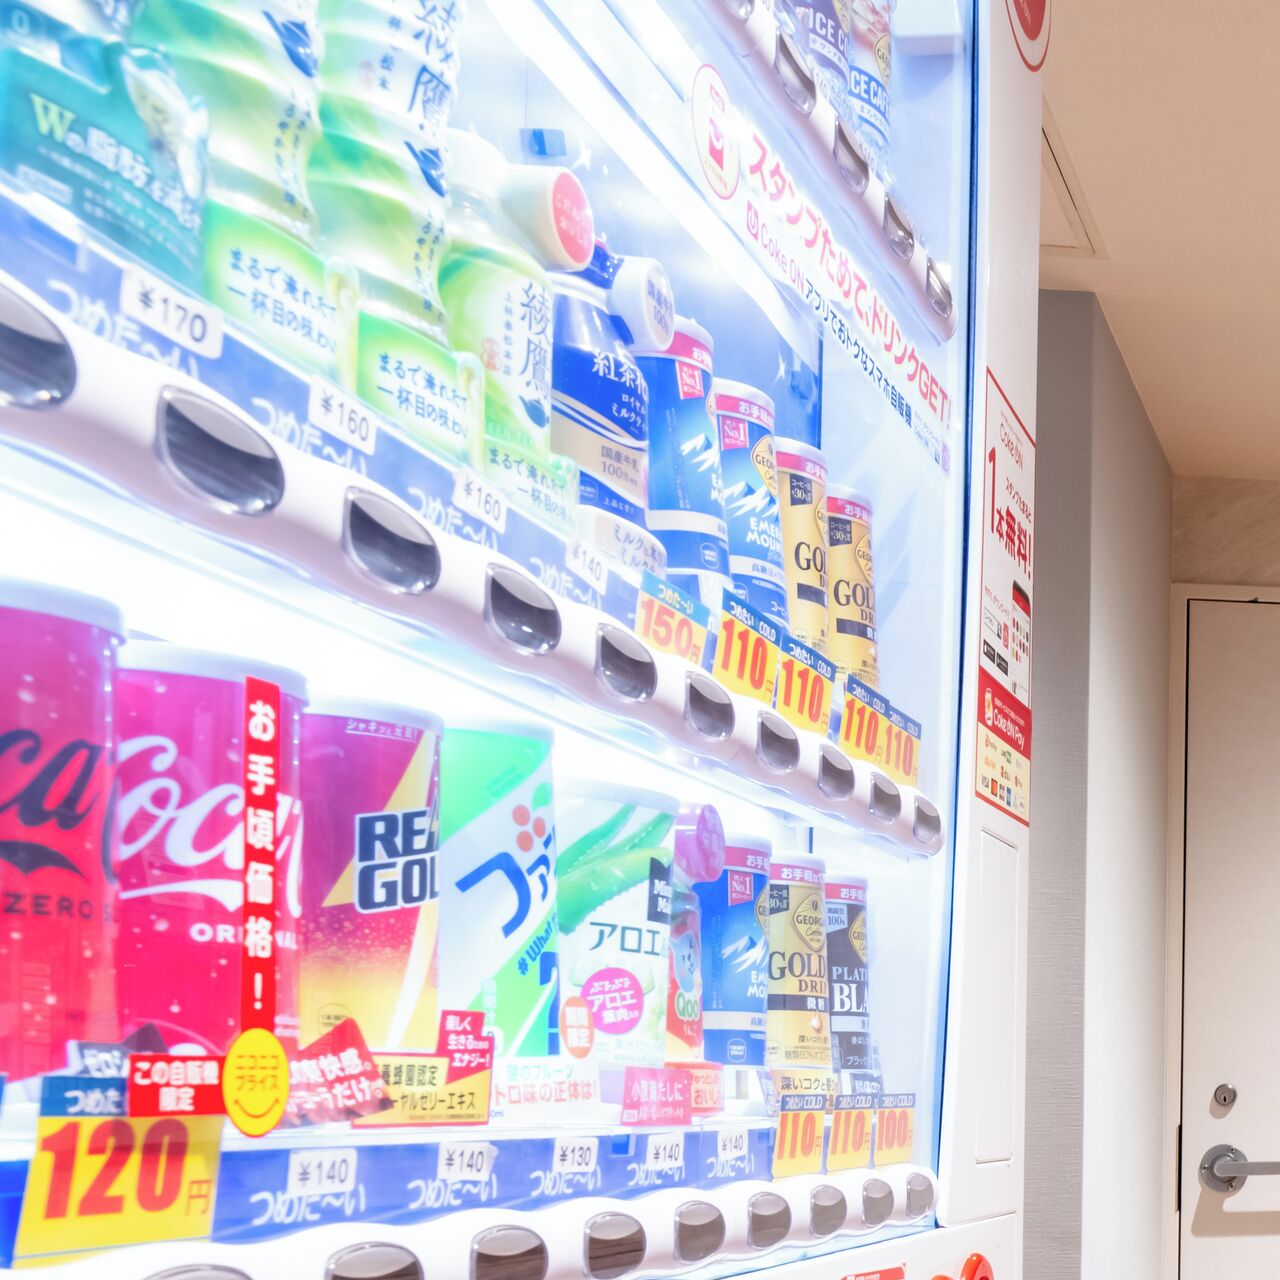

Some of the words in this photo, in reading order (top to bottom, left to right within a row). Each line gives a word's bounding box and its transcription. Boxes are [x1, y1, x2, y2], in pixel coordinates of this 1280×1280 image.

[137, 285, 208, 344] ¥170
[320, 388, 369, 443] ¥160
[463, 478, 502, 523] ¥160
[245, 699, 277, 1011] お手頃価格!
[589, 920, 661, 957] アロエ
[586, 989, 638, 1013] アロエ
[452, 1051, 492, 1068] エナジー!
[133, 1060, 220, 1086] この自販機
[159, 1086, 196, 1113] 限定
[391, 1091, 477, 1111] ーヤルゼリーエキス
[558, 1145, 592, 1168] ¥130
[652, 1142, 680, 1162] ¥140
[720, 1134, 744, 1153] ¥140
[298, 1159, 349, 1188] ¥140
[445, 1149, 485, 1174] ¥140
